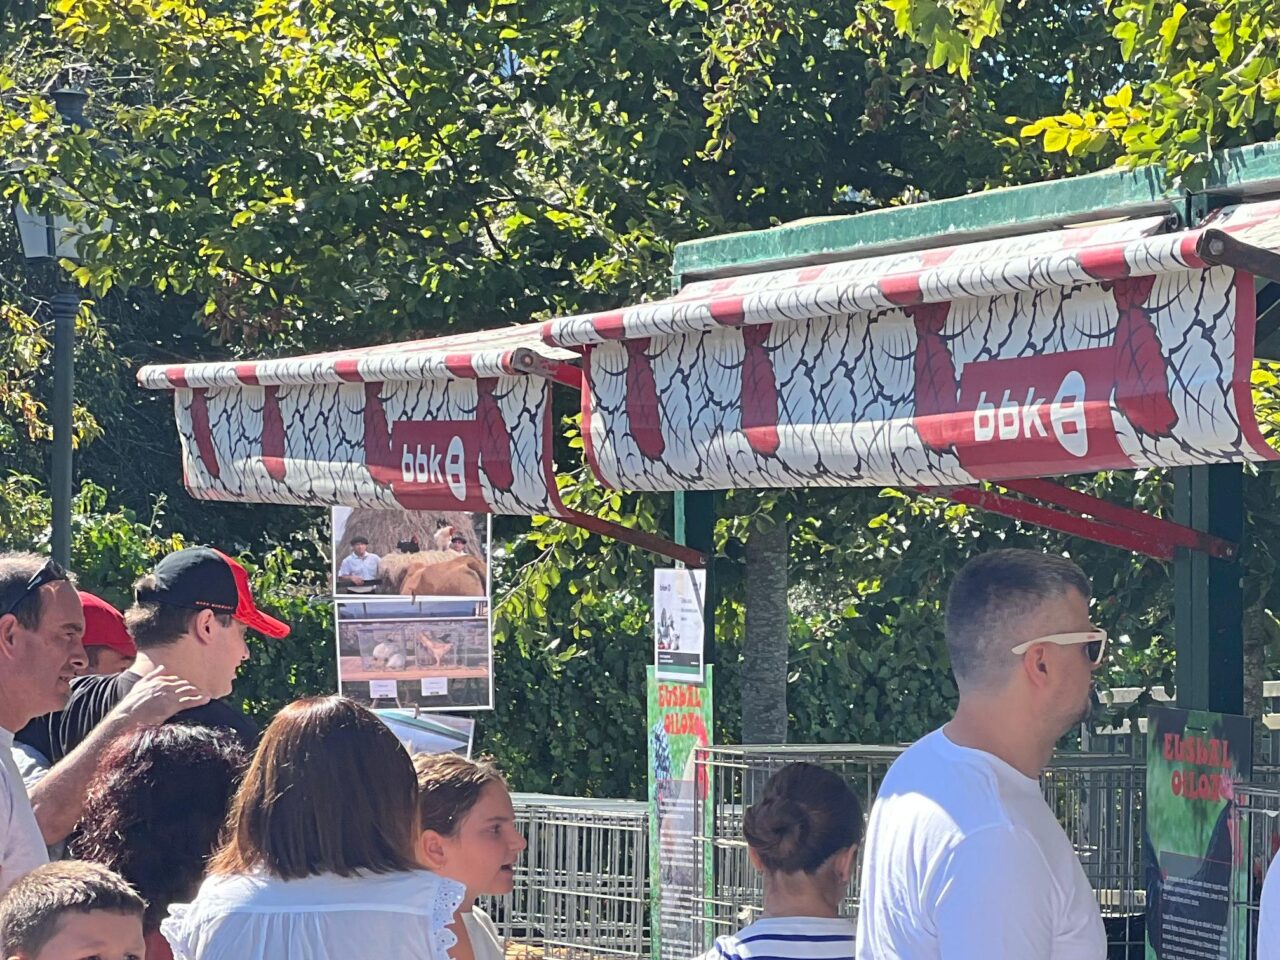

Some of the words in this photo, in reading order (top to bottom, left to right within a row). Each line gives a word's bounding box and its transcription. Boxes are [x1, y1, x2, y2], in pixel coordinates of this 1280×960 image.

[974, 387, 1048, 442] bbk
[402, 444, 444, 484] bbk
[1163, 733, 1232, 768] EUSKAL
